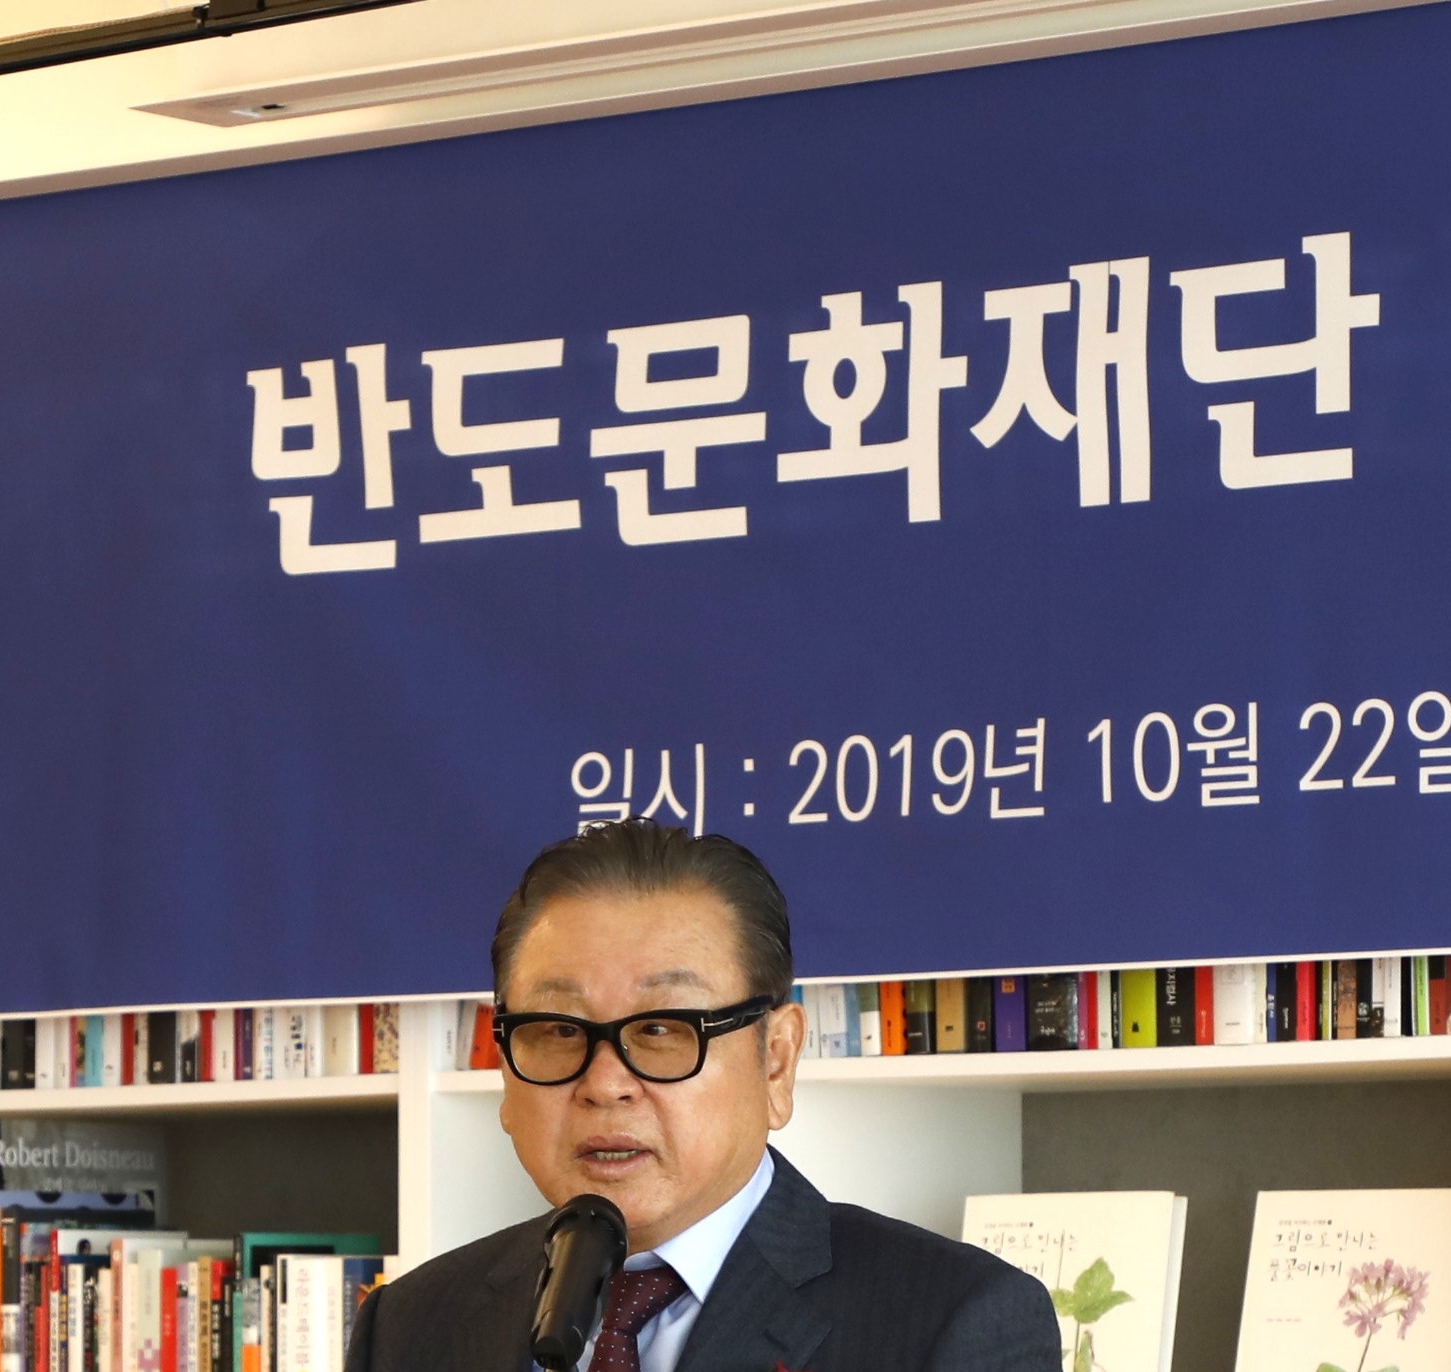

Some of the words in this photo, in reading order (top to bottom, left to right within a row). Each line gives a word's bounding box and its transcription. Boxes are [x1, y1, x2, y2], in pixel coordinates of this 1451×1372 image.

[247, 232, 1380, 575] 반도문화재단
[572, 744, 704, 837] 일시
[789, 718, 1044, 824] 2019년
[1088, 703, 1260, 806] 10월
[64, 1140, 155, 1170] Doisneau
